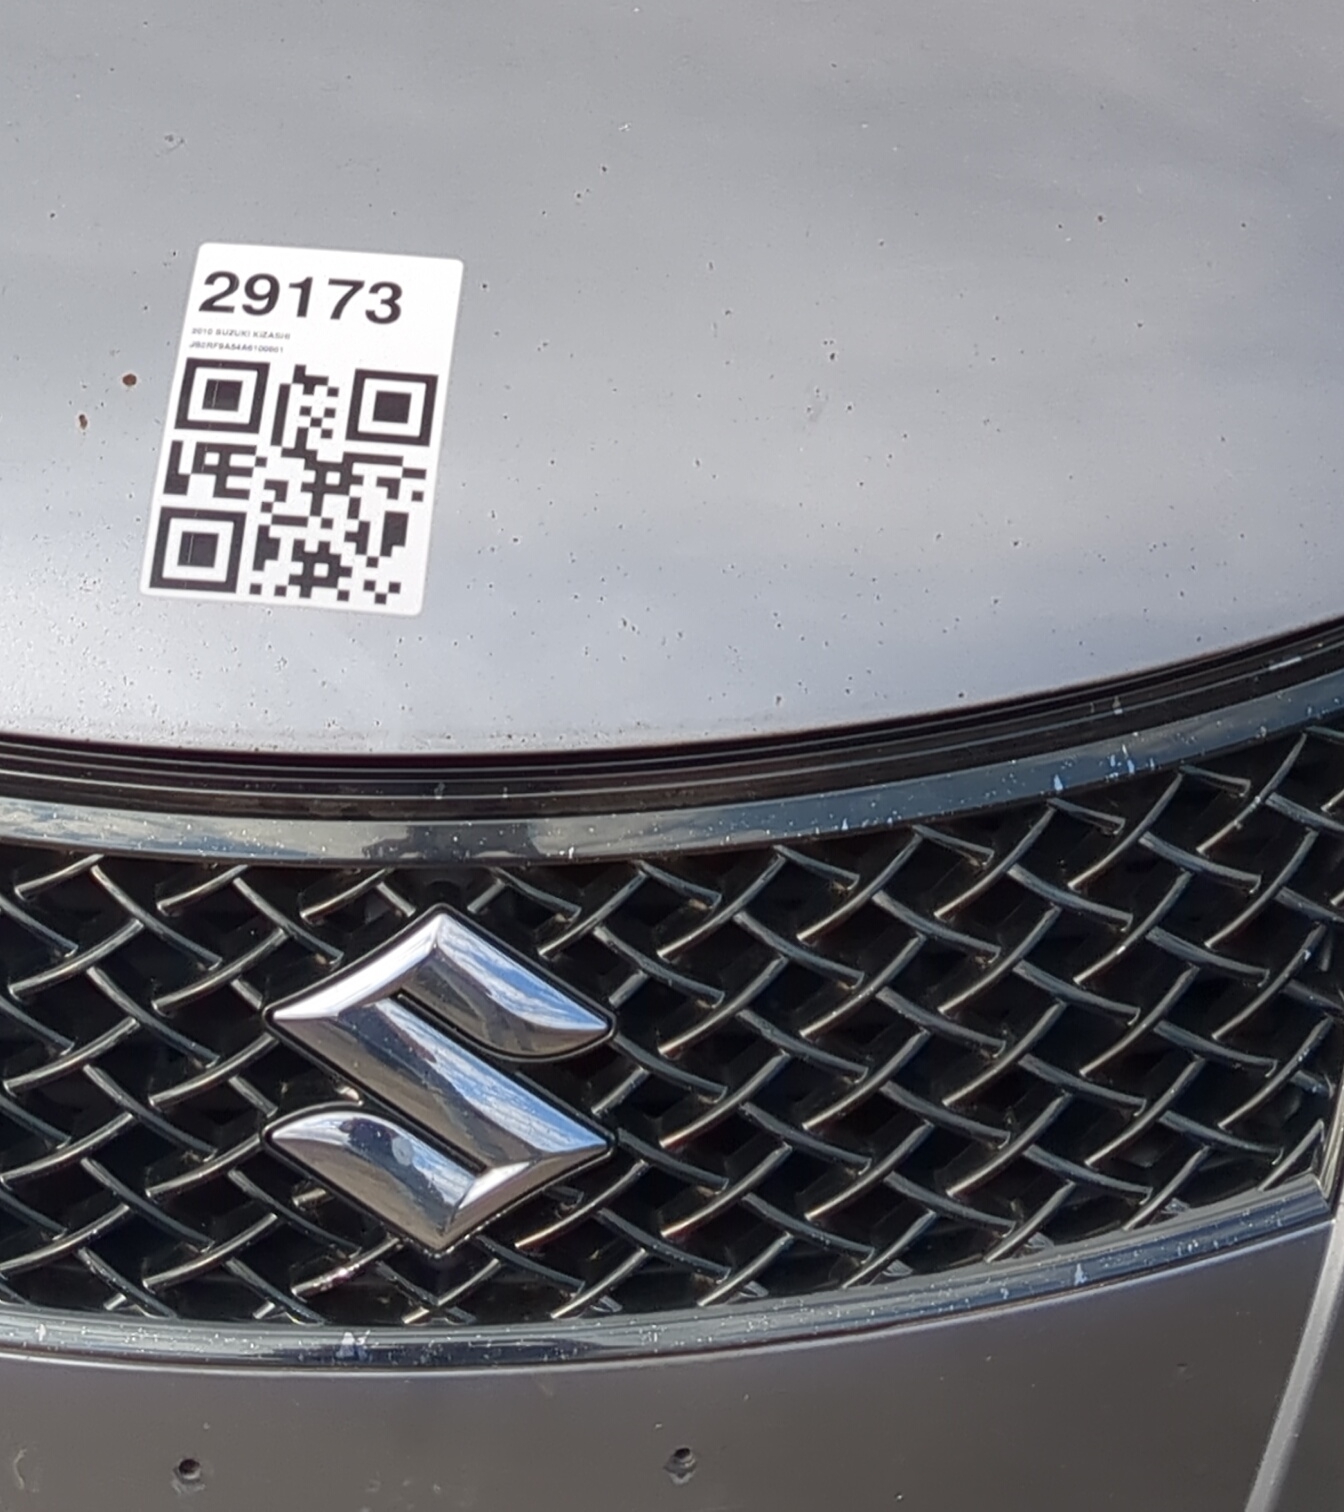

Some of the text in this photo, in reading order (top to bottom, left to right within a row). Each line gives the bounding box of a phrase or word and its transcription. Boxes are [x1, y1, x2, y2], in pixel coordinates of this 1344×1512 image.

[198, 270, 403, 325] 29173
[191, 327, 291, 340] 2010 SUZUKI KIZASHI
